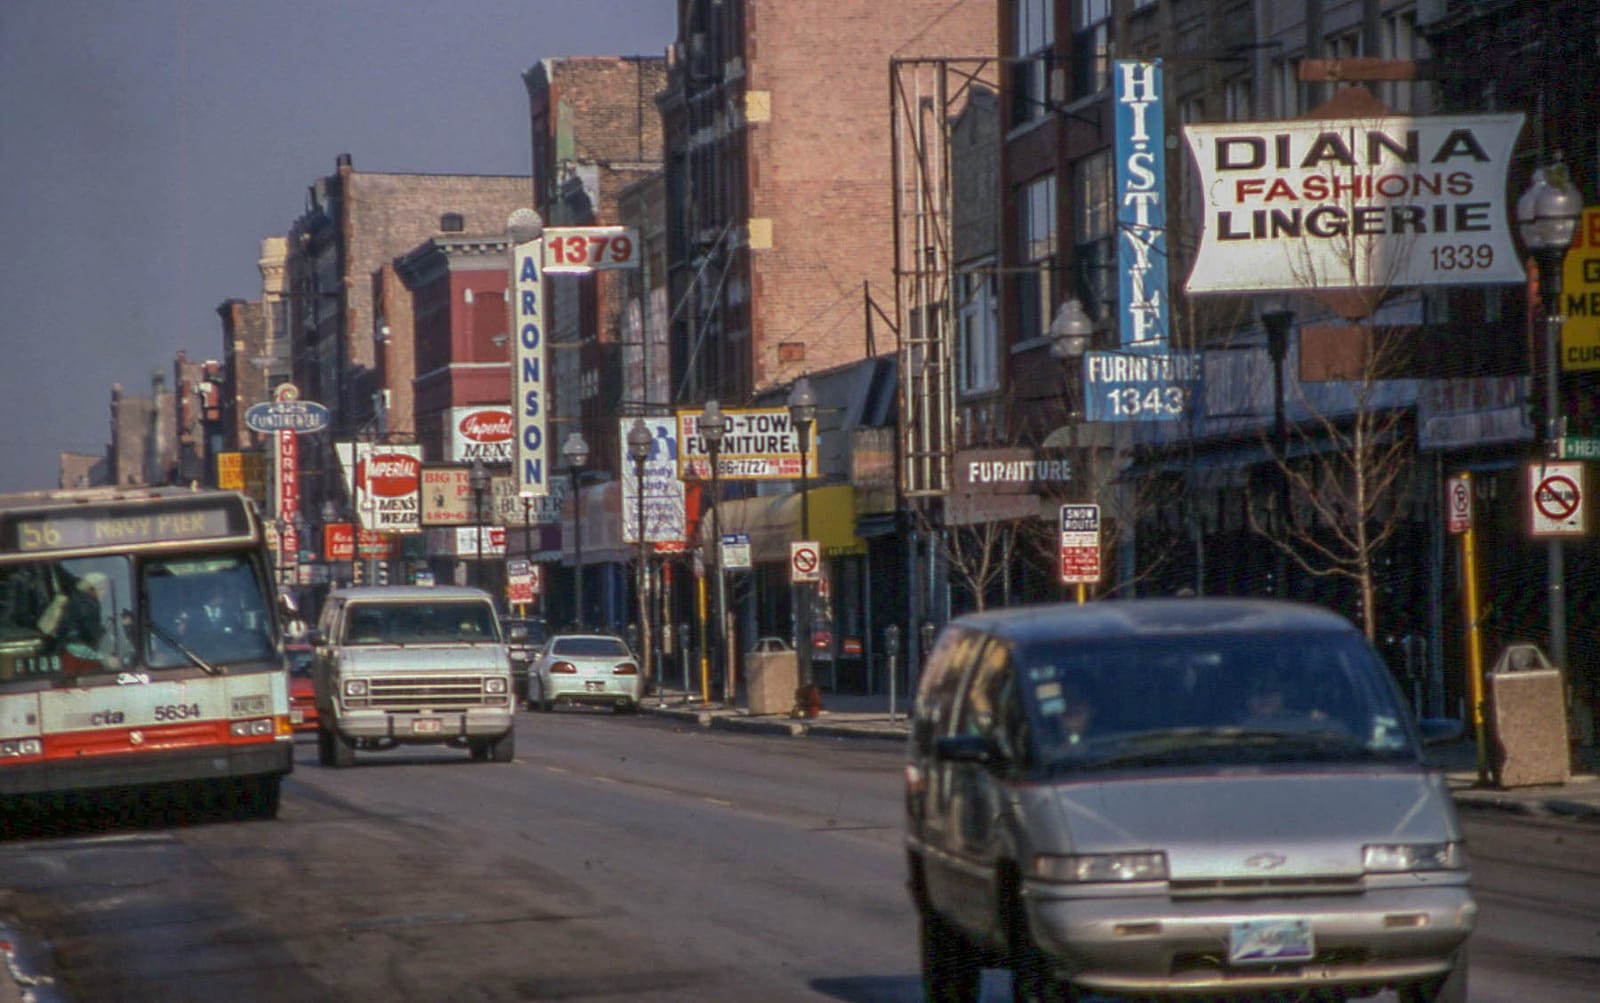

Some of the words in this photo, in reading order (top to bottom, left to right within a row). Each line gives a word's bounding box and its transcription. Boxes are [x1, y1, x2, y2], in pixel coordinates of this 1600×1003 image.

[1214, 128, 1491, 172] DIANA
[1236, 172, 1475, 204] FASHIONS
[1217, 202, 1493, 241] LINGERIE
[548, 235, 633, 264] 1379
[1429, 244, 1494, 272] 1339
[519, 255, 543, 486] ARONSON
[1088, 353, 1201, 384] FURNITURE
[1107, 386, 1185, 416] 1343
[424, 472, 450, 483] BIG
[969, 459, 1072, 483] FURNITURE
[281, 429, 297, 551] FURNITURE
[1066, 508, 1095, 519] SNOW
[22, 521, 61, 548] 56
[90, 706, 125, 727] cta
[154, 702, 201, 722] 5634
